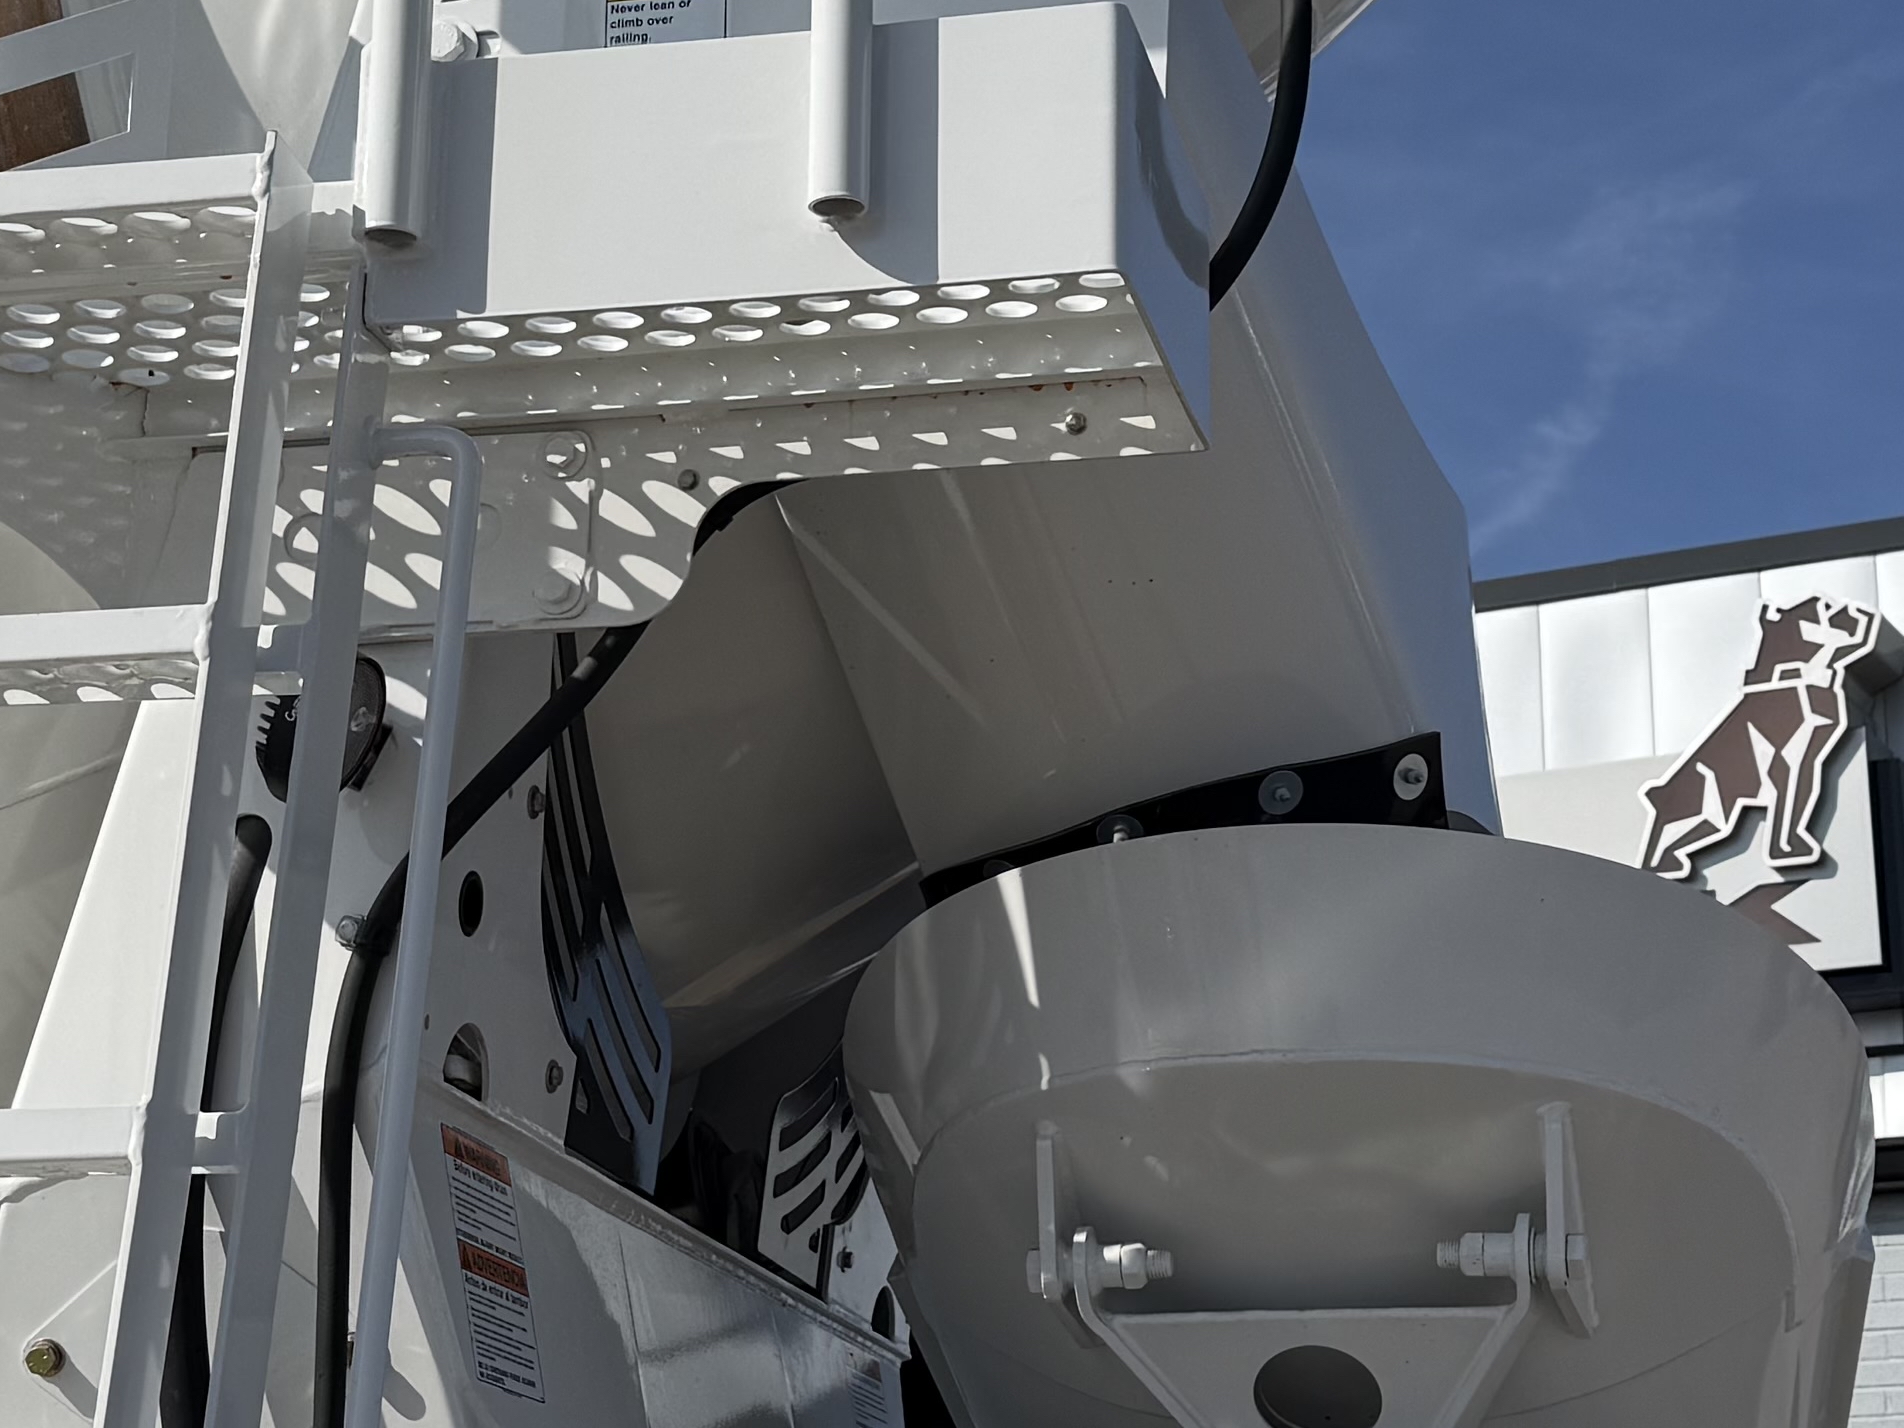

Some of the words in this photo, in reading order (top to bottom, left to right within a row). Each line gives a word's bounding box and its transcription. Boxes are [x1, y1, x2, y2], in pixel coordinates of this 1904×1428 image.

[610, 3, 646, 15] Never
[649, 0, 675, 11] lean
[678, 0, 692, 9] or
[609, 17, 643, 29] climb
[647, 16, 674, 26] over
